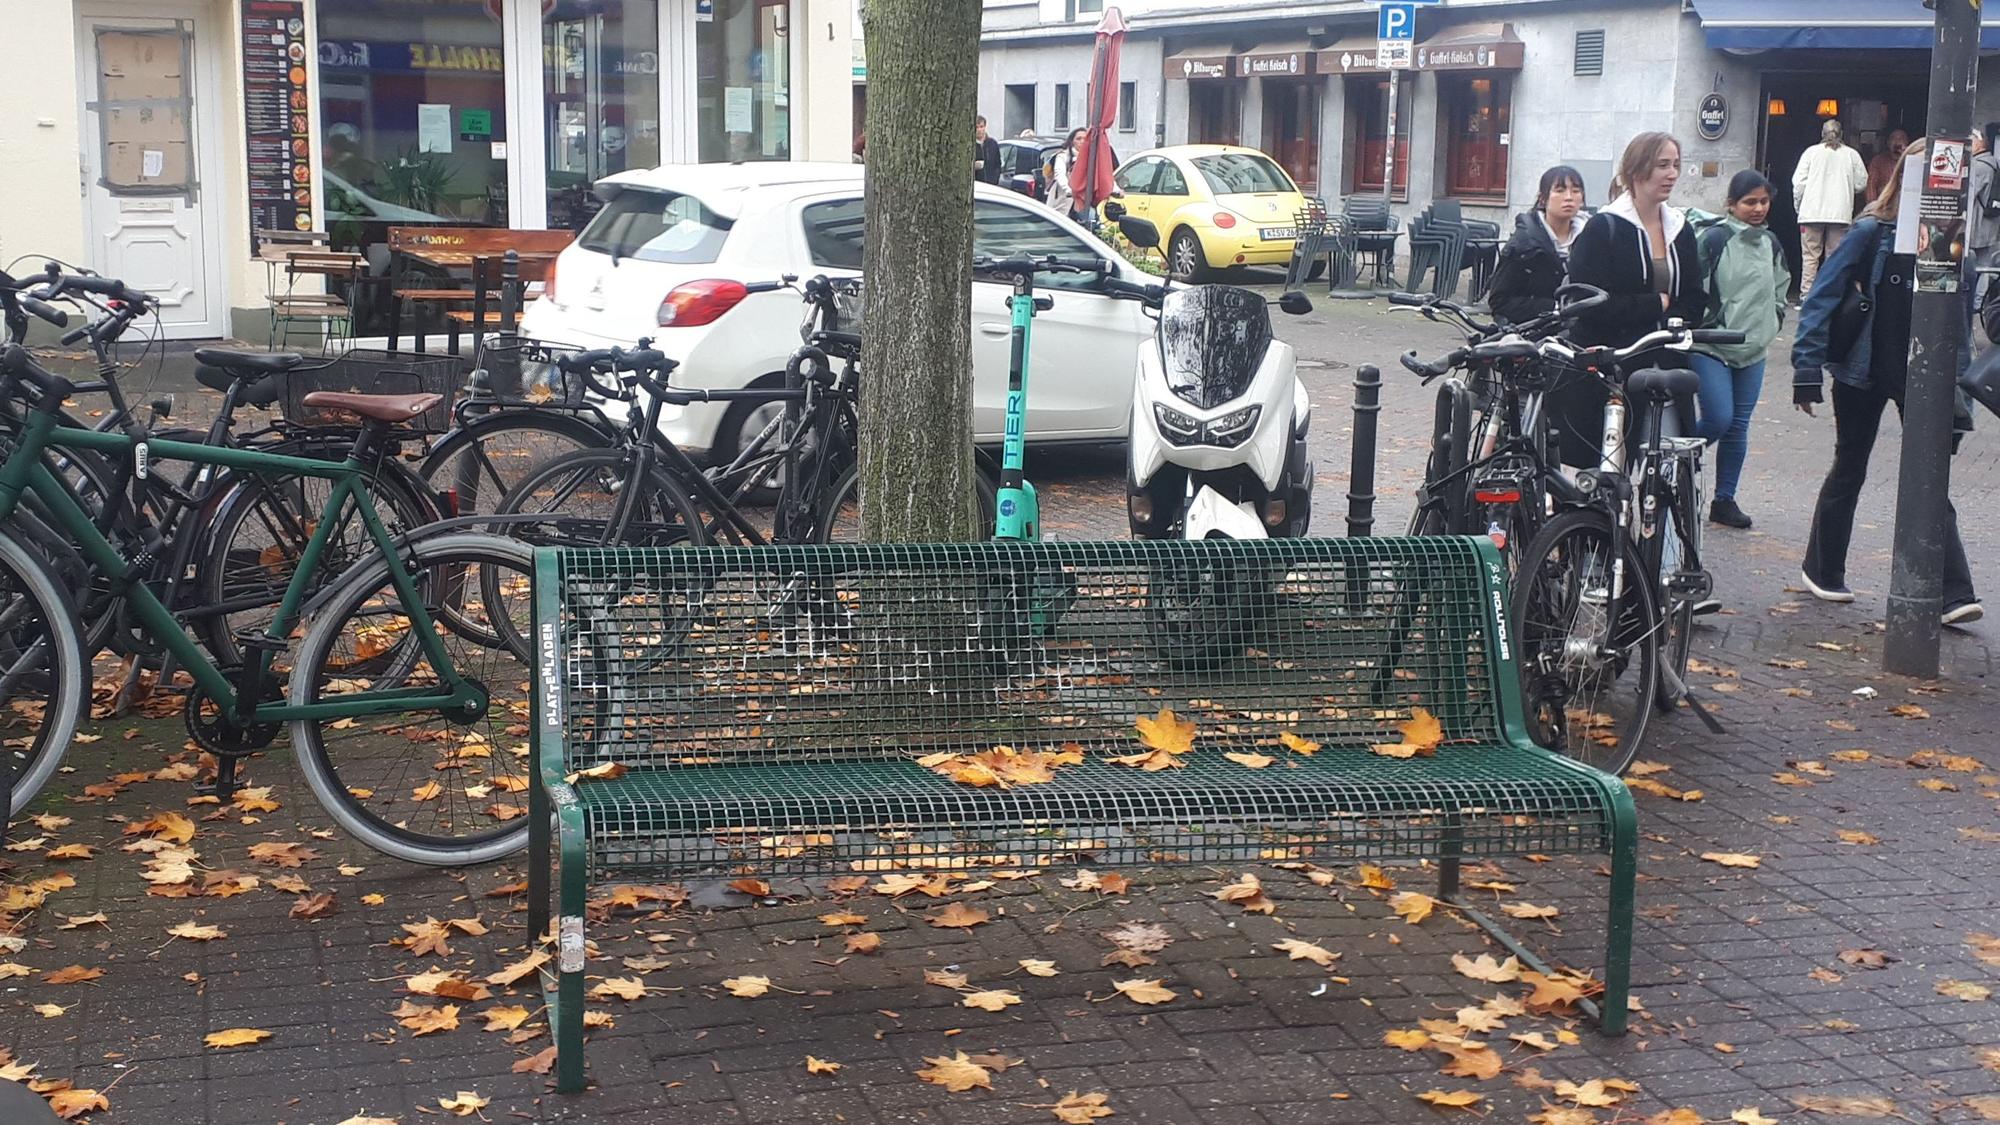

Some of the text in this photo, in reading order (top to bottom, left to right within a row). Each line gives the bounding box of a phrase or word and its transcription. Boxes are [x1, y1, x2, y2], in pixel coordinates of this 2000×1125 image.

[1387, 8, 1406, 38] P
[1702, 110, 1724, 119] Gaffel
[1004, 395, 1021, 465] TIER
[542, 623, 560, 726] PLATTENLADEN
